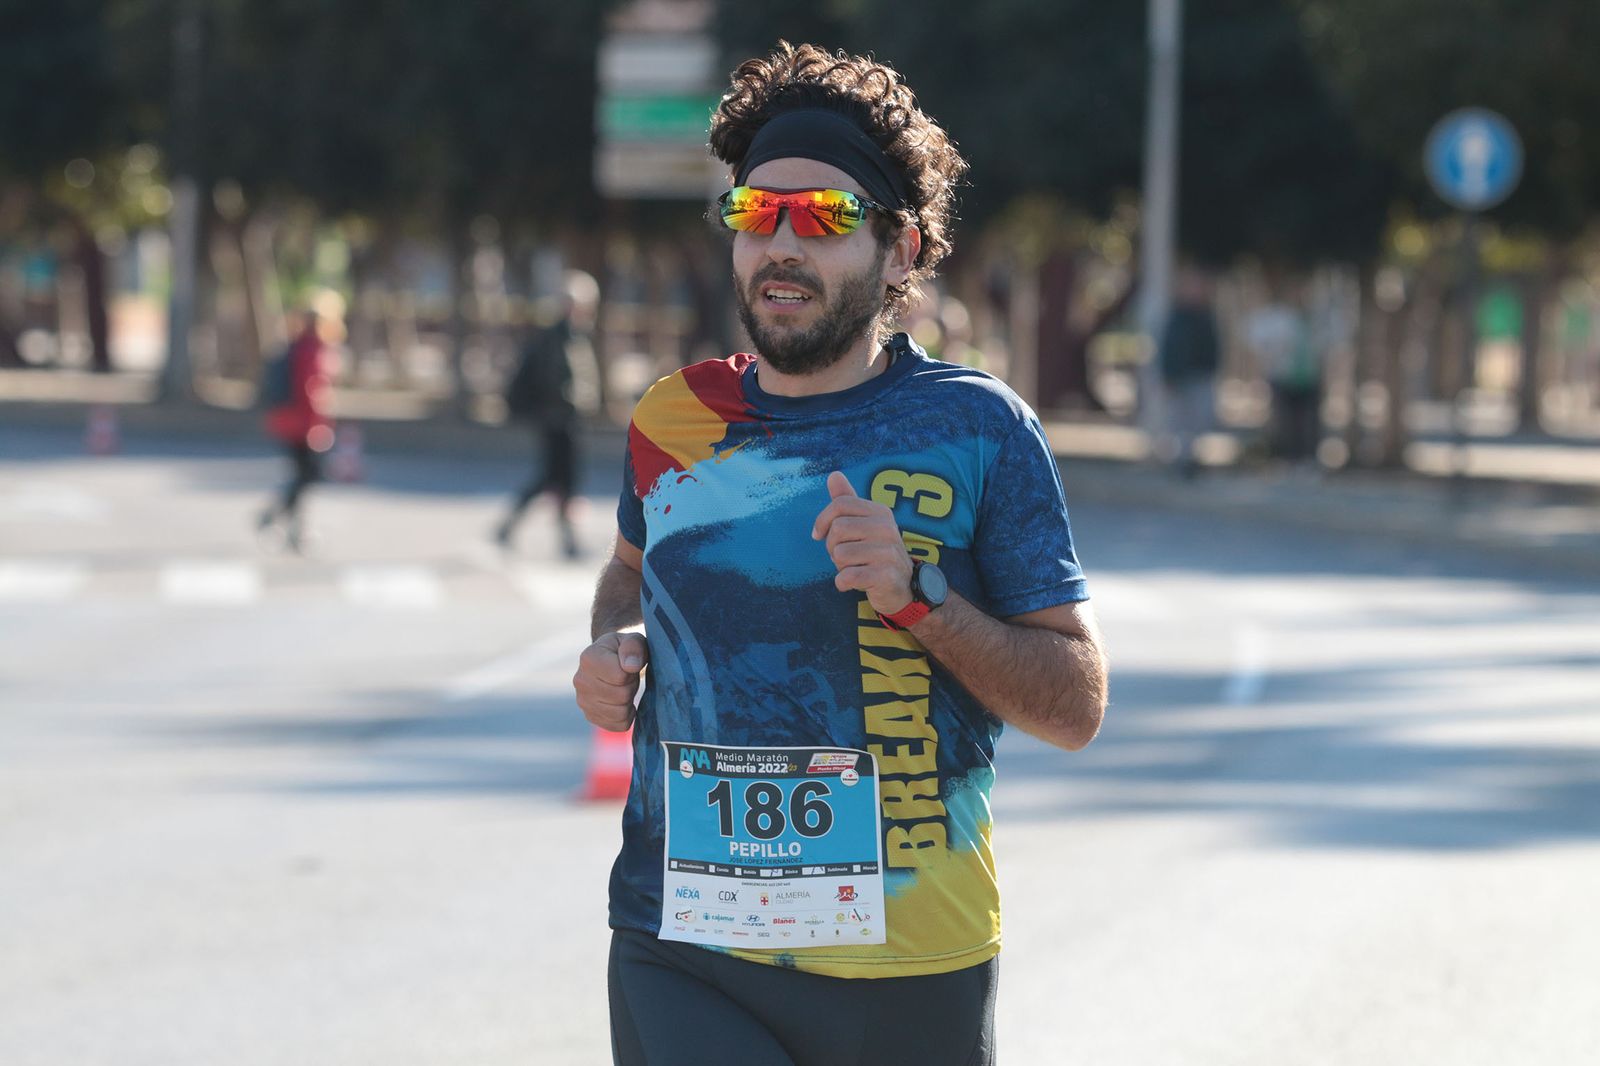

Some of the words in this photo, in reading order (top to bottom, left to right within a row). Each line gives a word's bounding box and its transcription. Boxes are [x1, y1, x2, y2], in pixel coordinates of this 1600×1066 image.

[870, 468, 954, 519] 3
[715, 752, 743, 762] Medio
[746, 753, 789, 763] Maratón
[716, 762, 756, 774] Almería
[706, 780, 834, 841] 186
[729, 841, 801, 857] PEPILLO
[675, 887, 700, 900] NEXA
[718, 890, 738, 902] CDX
[775, 891, 811, 900] ALMERÍA
[712, 914, 735, 922] cajamar
[773, 917, 796, 925] Blanes
